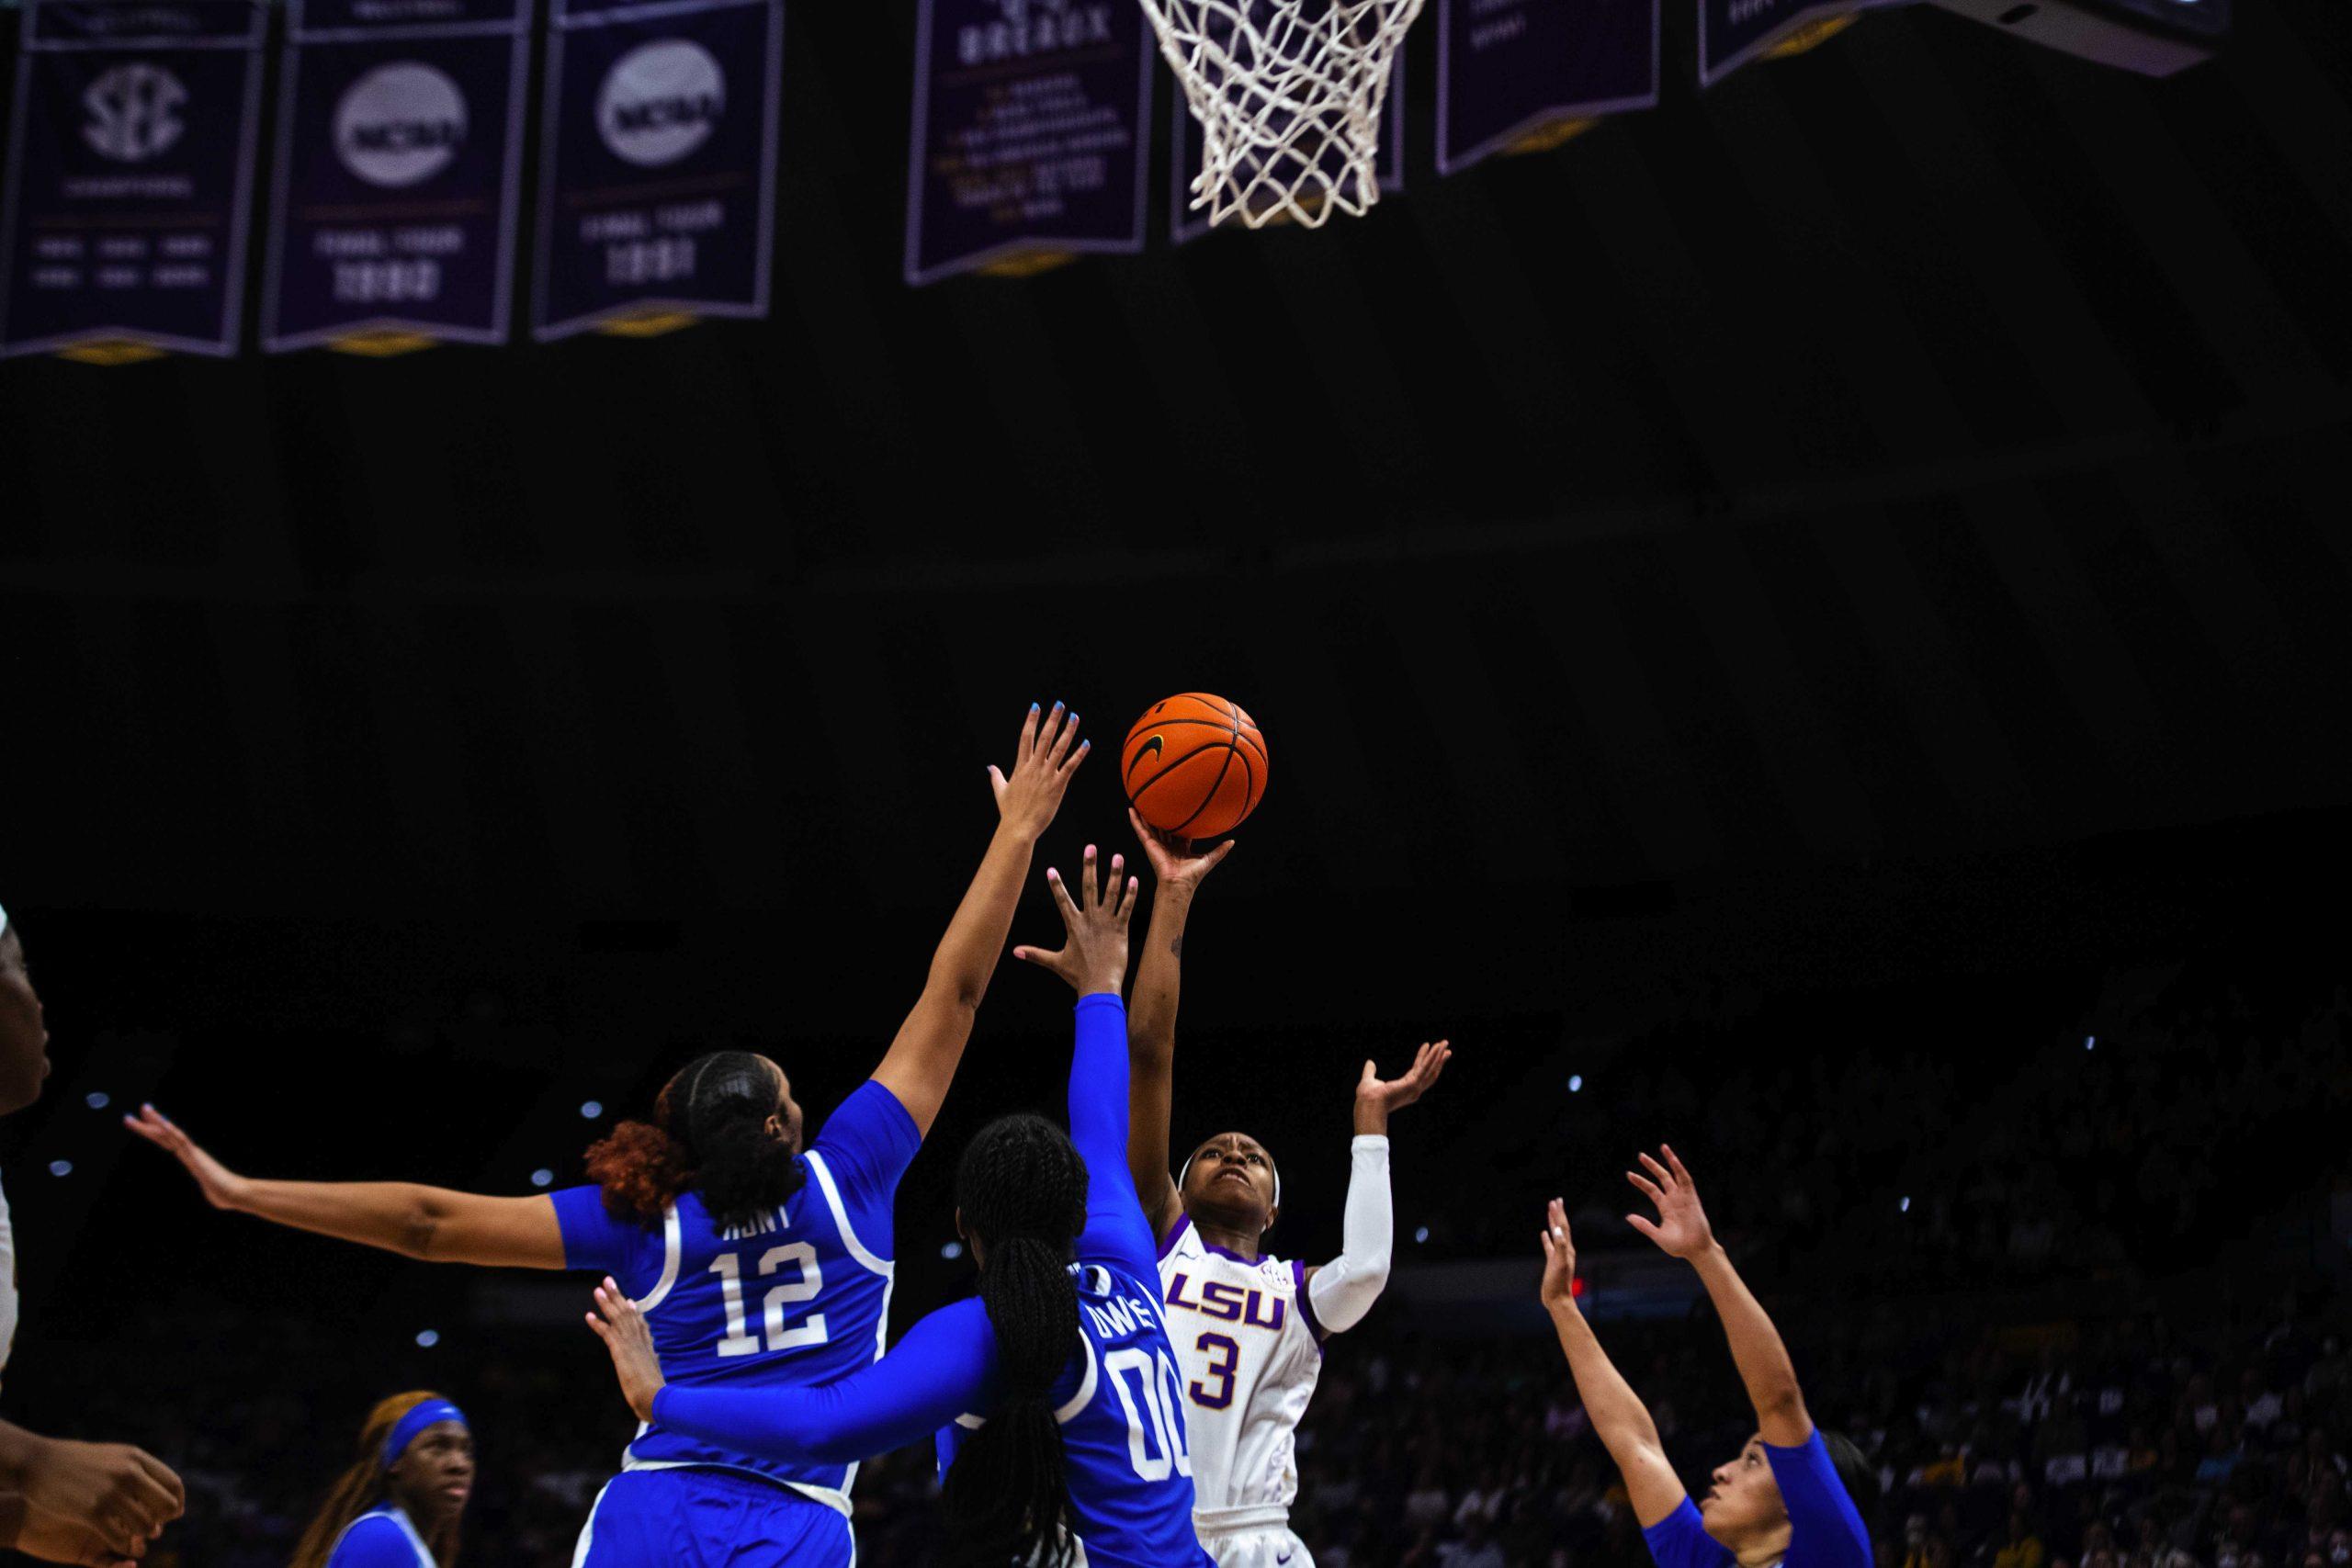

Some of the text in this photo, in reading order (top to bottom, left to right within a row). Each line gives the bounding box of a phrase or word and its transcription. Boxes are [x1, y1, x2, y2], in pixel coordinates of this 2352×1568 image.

[353, 120, 470, 152] NCAA
[616, 94, 729, 131] NCAA
[707, 1240, 829, 1358] 12
[1165, 1272, 1285, 1331] LSU
[1189, 1331, 1240, 1411] 3
